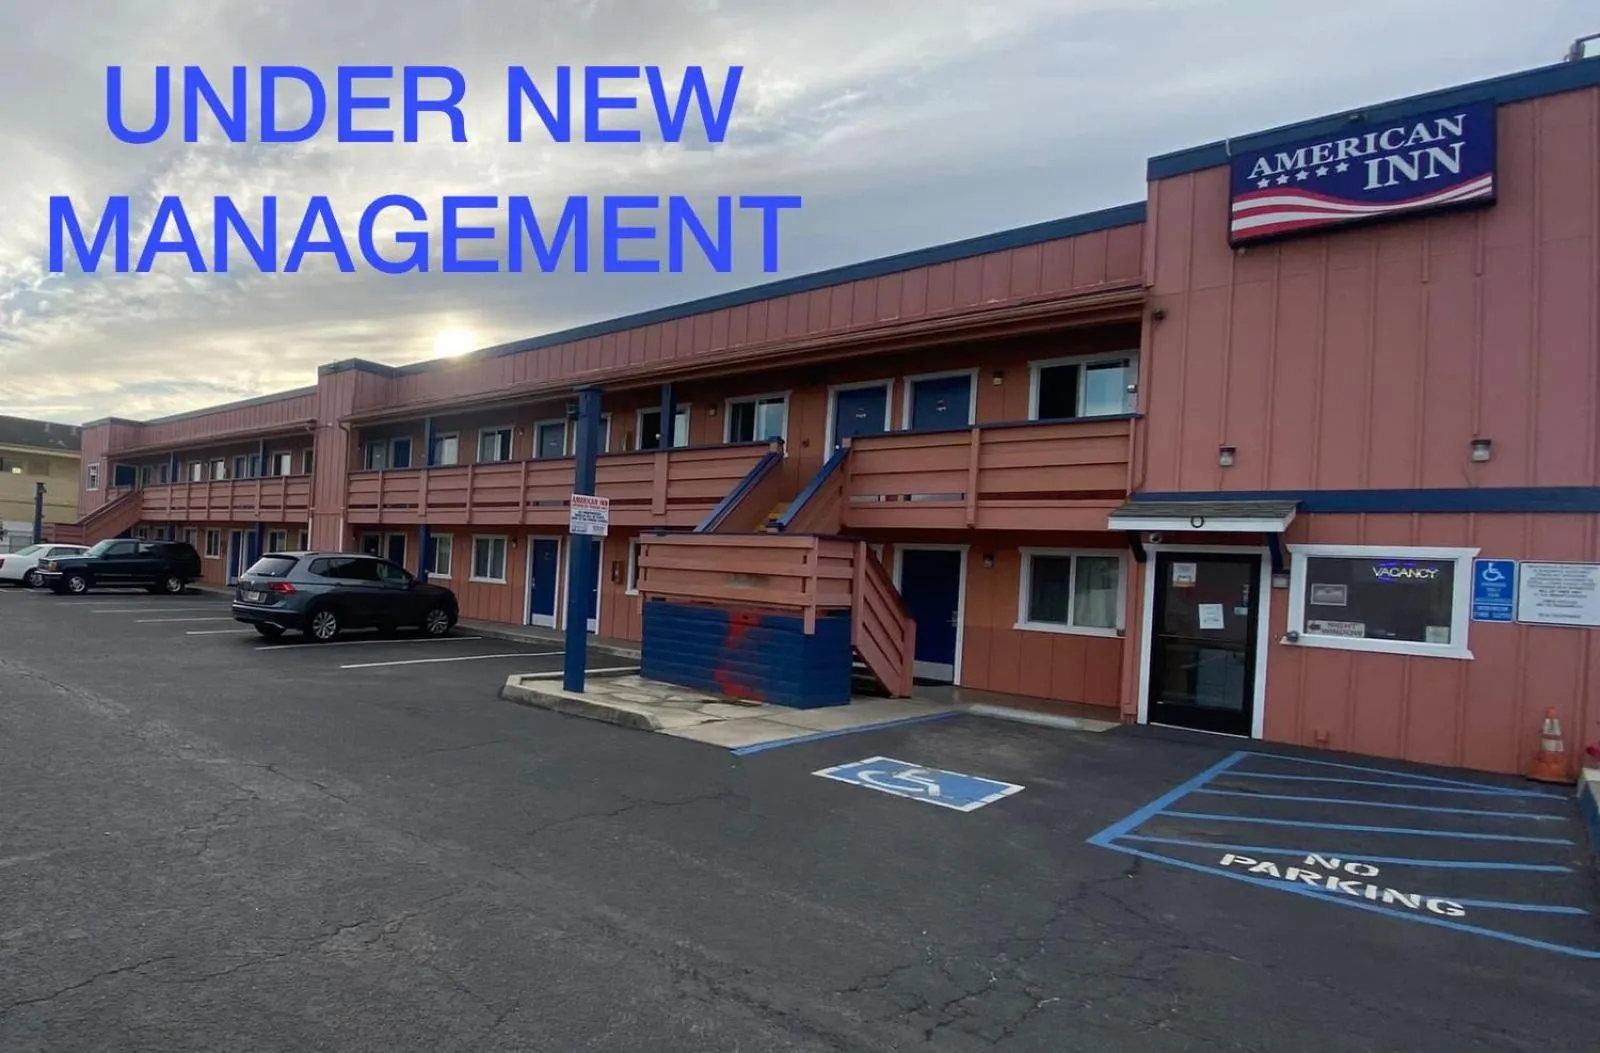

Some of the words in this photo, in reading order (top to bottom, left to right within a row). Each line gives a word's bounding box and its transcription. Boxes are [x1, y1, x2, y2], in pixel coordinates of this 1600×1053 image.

[1247, 113, 1467, 180] AMERICAN
[1362, 141, 1466, 191] INN
[1372, 566, 1440, 579] VACANCY
[1219, 853, 1466, 917] PARKING
[1304, 852, 1380, 877] NO
